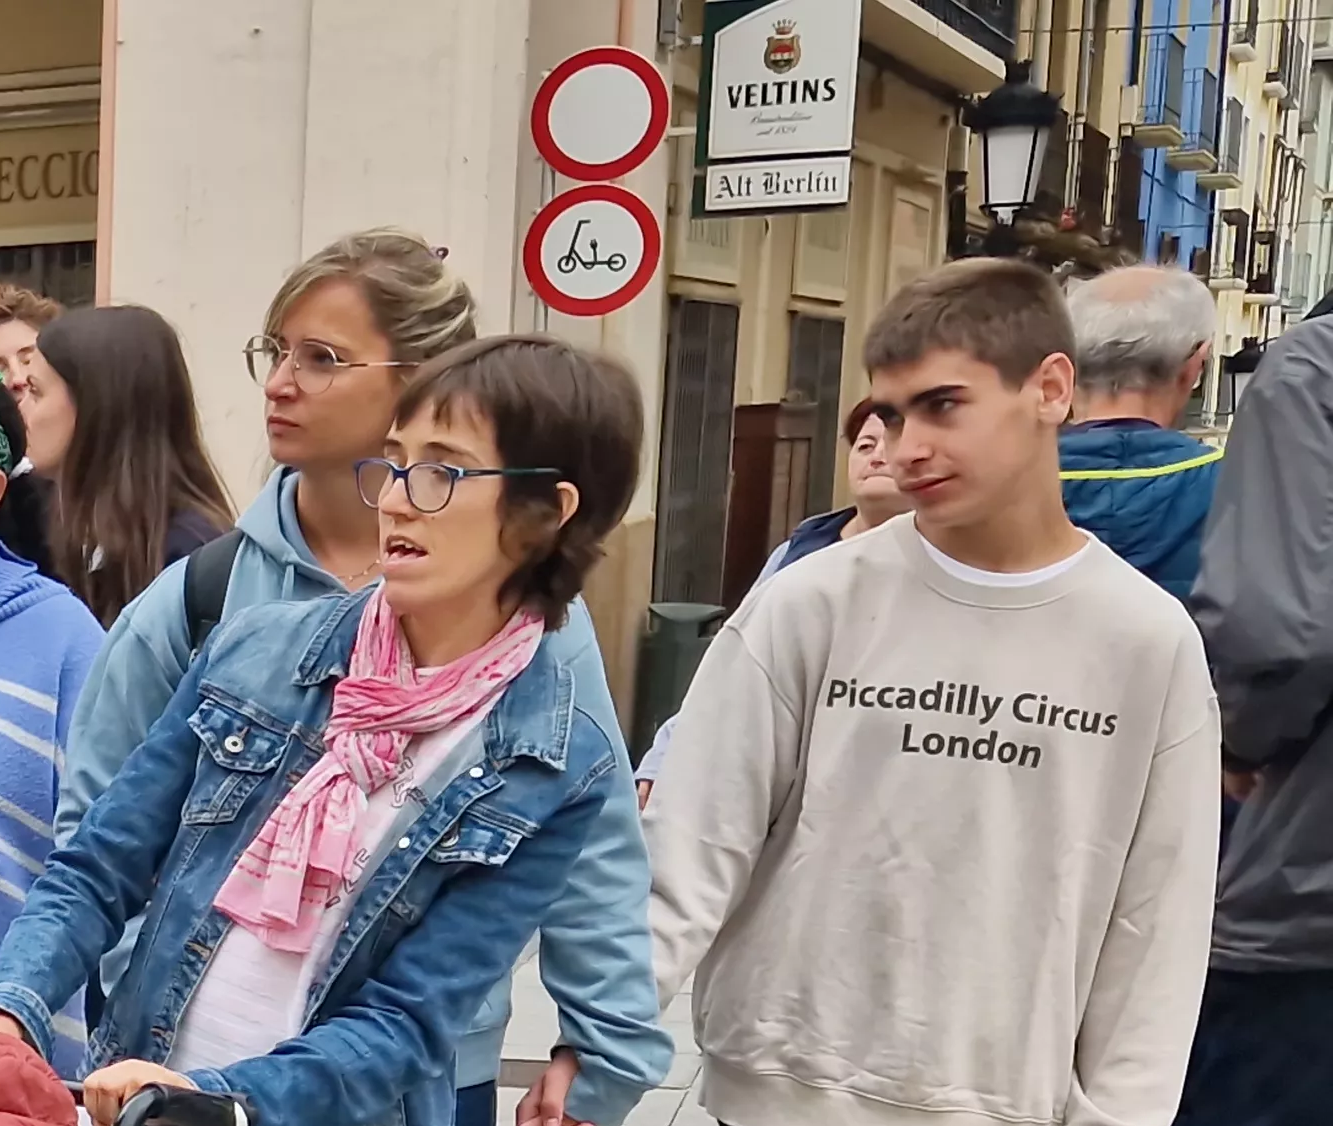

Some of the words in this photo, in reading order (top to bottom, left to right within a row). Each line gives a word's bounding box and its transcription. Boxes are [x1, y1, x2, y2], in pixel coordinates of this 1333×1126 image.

[727, 77, 836, 109] VELTINS
[714, 174, 753, 199] Alt
[825, 678, 1004, 726] Piccadilly
[1012, 693, 1119, 736] Circus
[901, 723, 1043, 769] London
